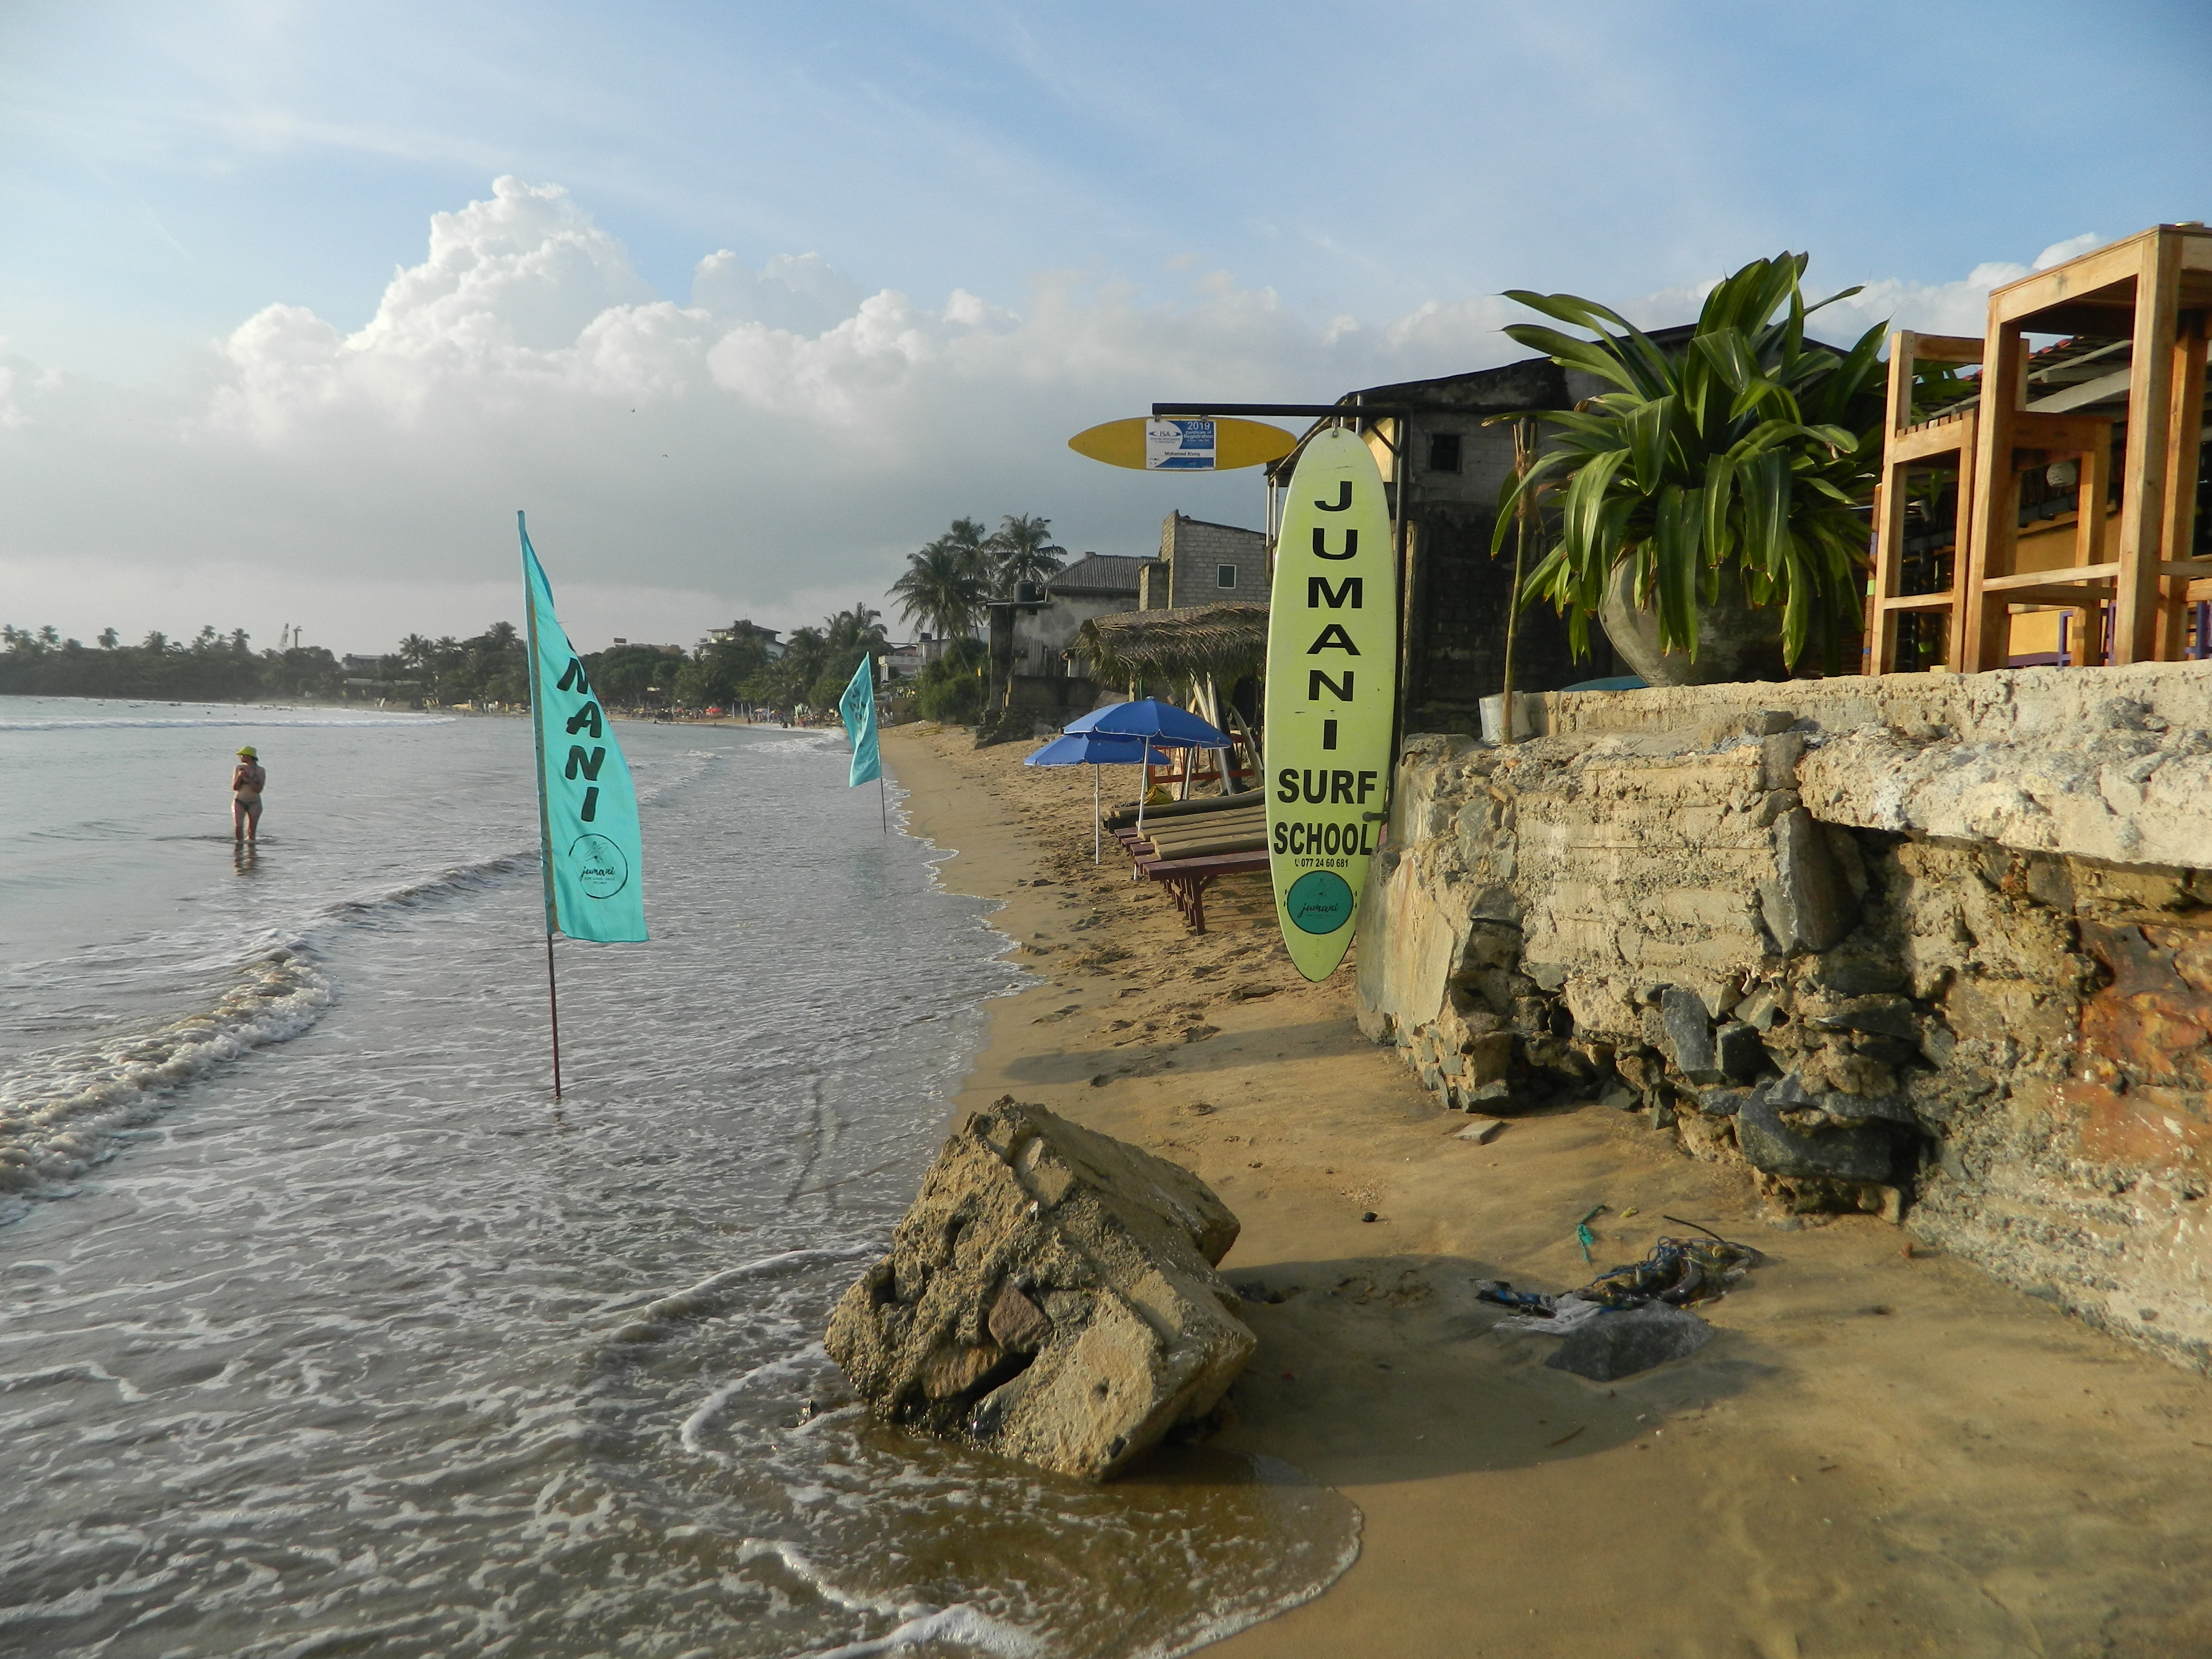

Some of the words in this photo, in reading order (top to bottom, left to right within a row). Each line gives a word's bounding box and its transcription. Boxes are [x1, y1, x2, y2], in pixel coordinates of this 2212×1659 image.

[1187, 421, 1210, 430] 2019
[1306, 481, 1363, 750] JUMANI
[1277, 768, 1377, 804] SURF
[1273, 822, 1374, 856] SCHOOL
[1301, 858, 1314, 867] 077
[1315, 858, 1324, 867] 24
[1326, 858, 1334, 867] 60
[1336, 858, 1348, 868] 681
[580, 866, 615, 881] jumani
[1296, 903, 1338, 918] jumani
